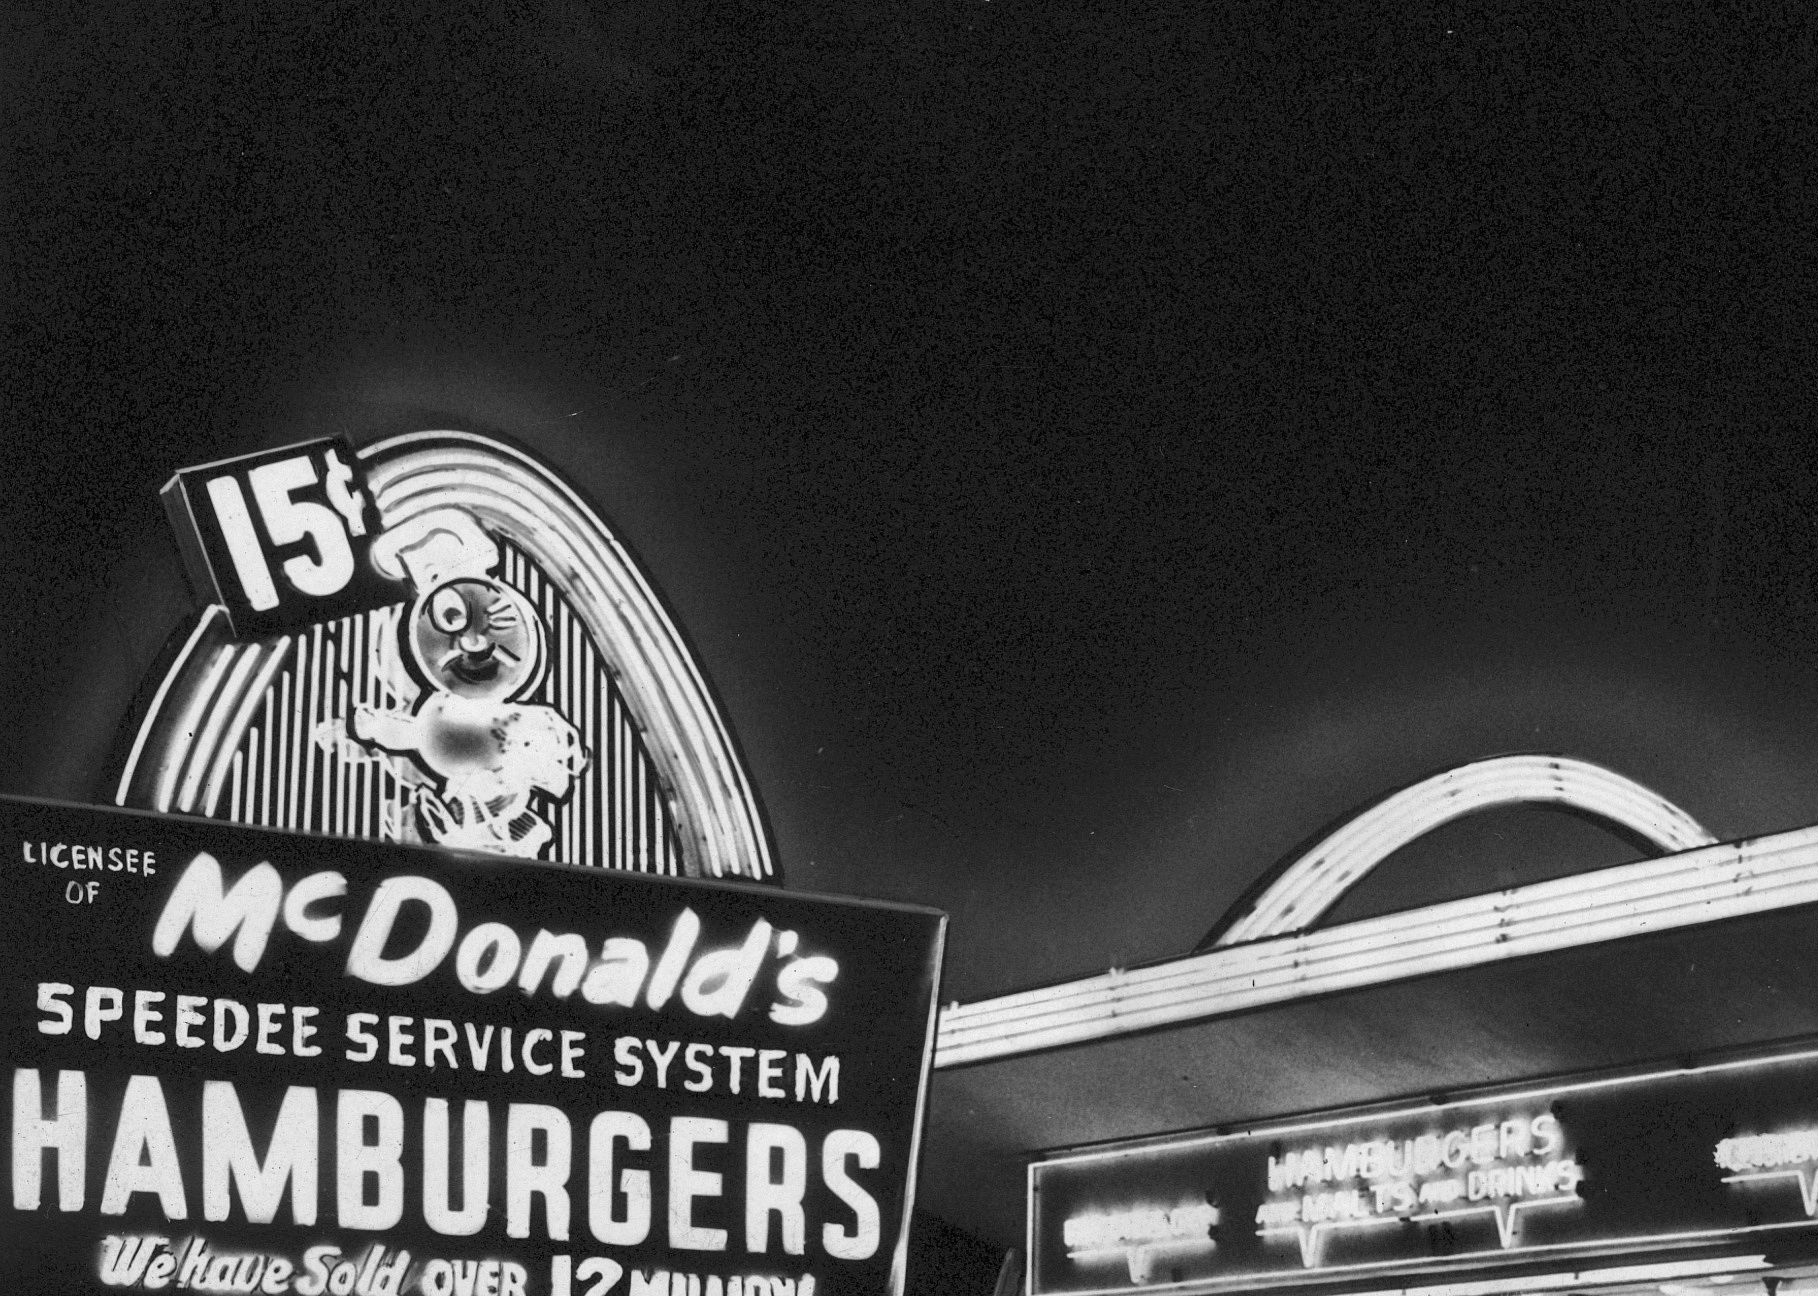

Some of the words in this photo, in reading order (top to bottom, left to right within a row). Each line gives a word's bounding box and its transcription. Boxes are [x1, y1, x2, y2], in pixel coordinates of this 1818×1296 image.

[205, 448, 368, 613] 15¢
[23, 841, 156, 877] LICENSEE
[65, 880, 100, 904] OF
[151, 850, 842, 1026] McDonald's
[36, 981, 322, 1057] SPEEDEE
[345, 1010, 586, 1079] SERVICE
[614, 1034, 841, 1104] SYSTEM
[9, 1067, 884, 1260] HAMBURGERS
[100, 1235, 176, 1289] We
[177, 1235, 293, 1294] have
